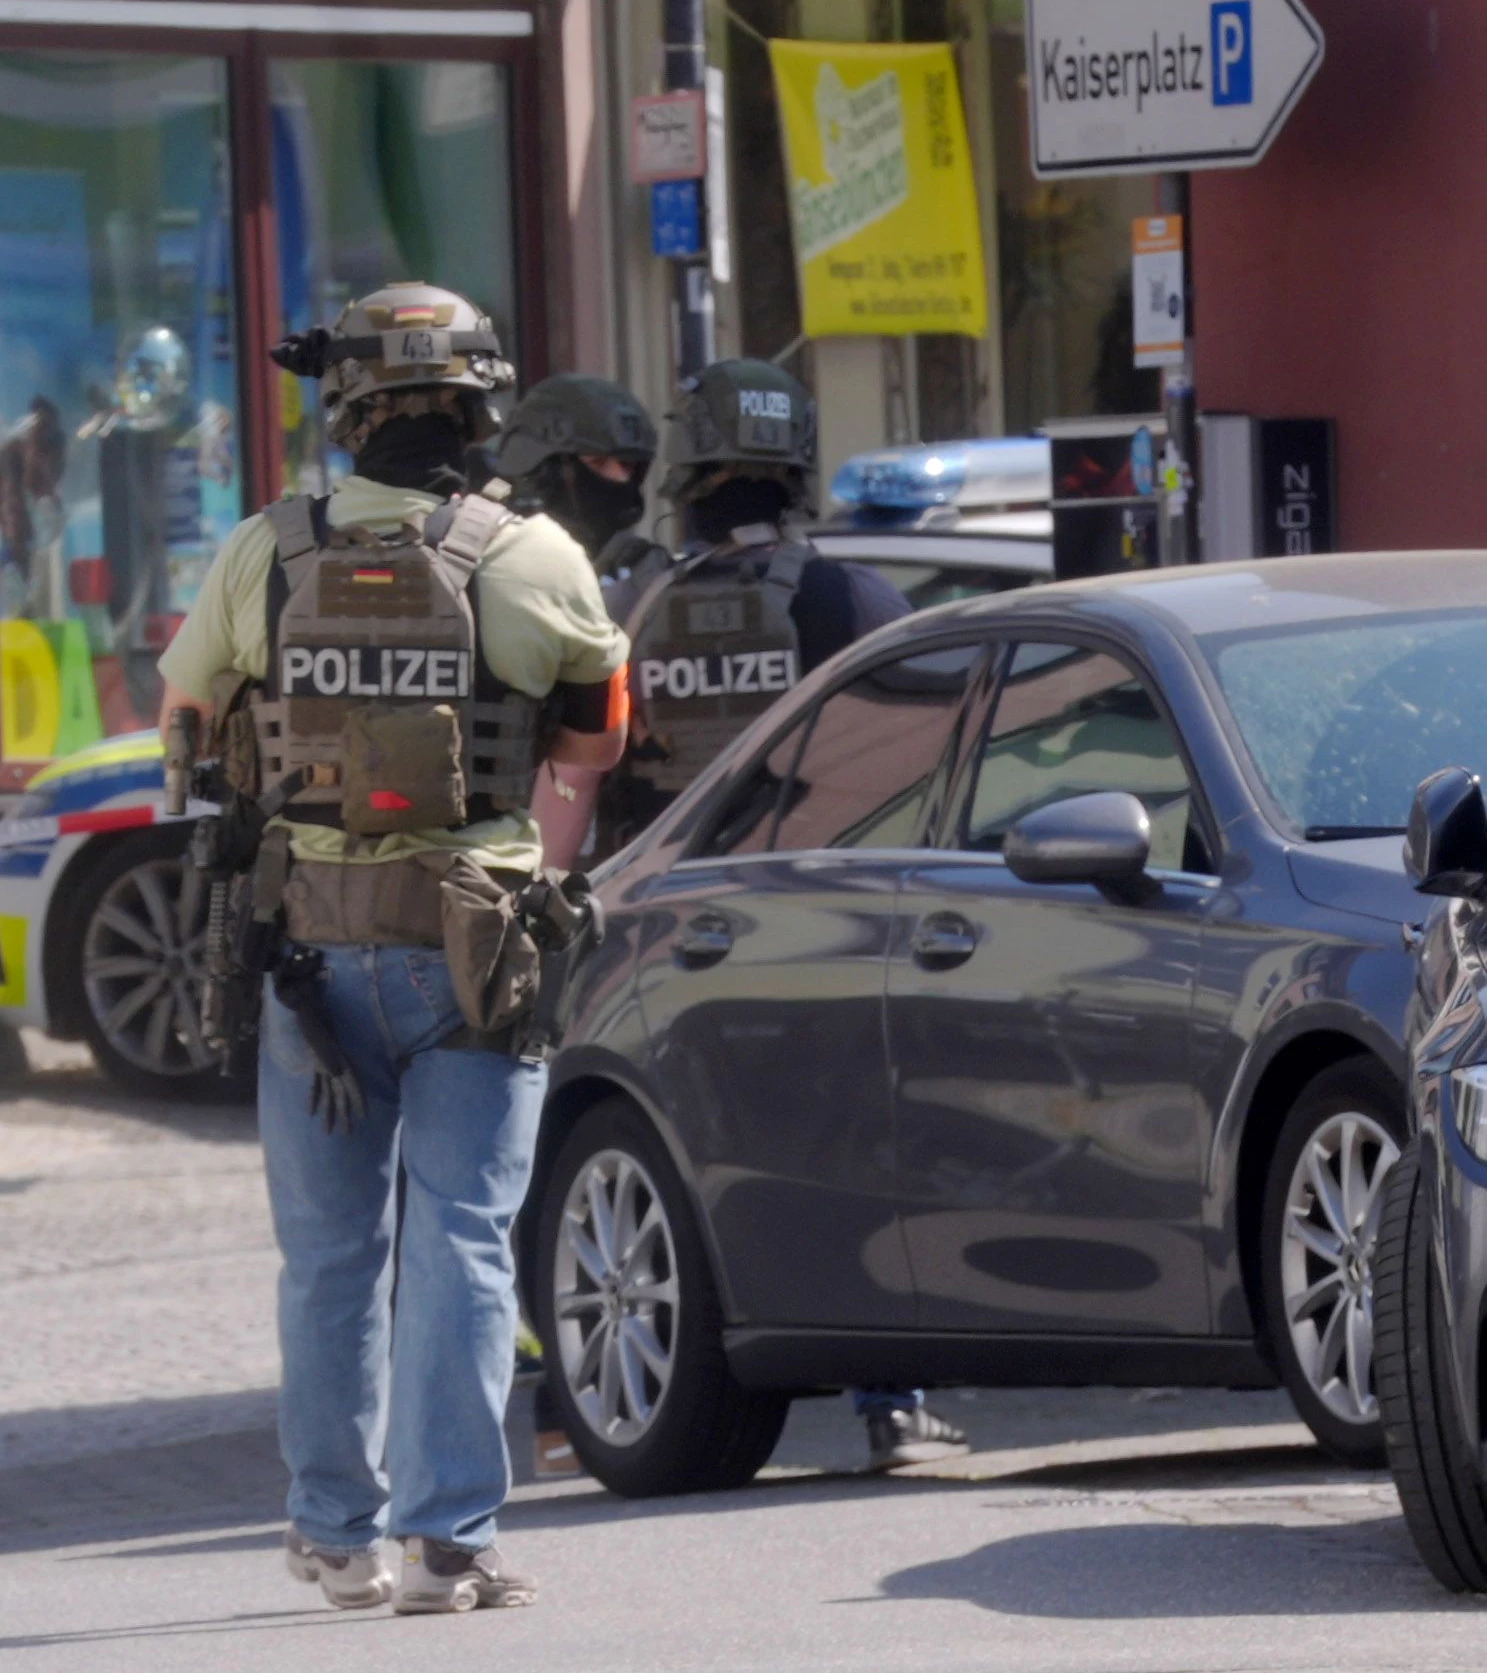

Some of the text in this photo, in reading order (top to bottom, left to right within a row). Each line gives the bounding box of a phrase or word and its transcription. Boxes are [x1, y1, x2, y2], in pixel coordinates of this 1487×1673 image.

[1040, 12, 1245, 114] Kaiserplatz P
[400, 329, 434, 359] 43
[739, 390, 791, 419] POLIZEI
[281, 647, 471, 697] POLIZEI
[639, 650, 797, 699] POLIZEI
